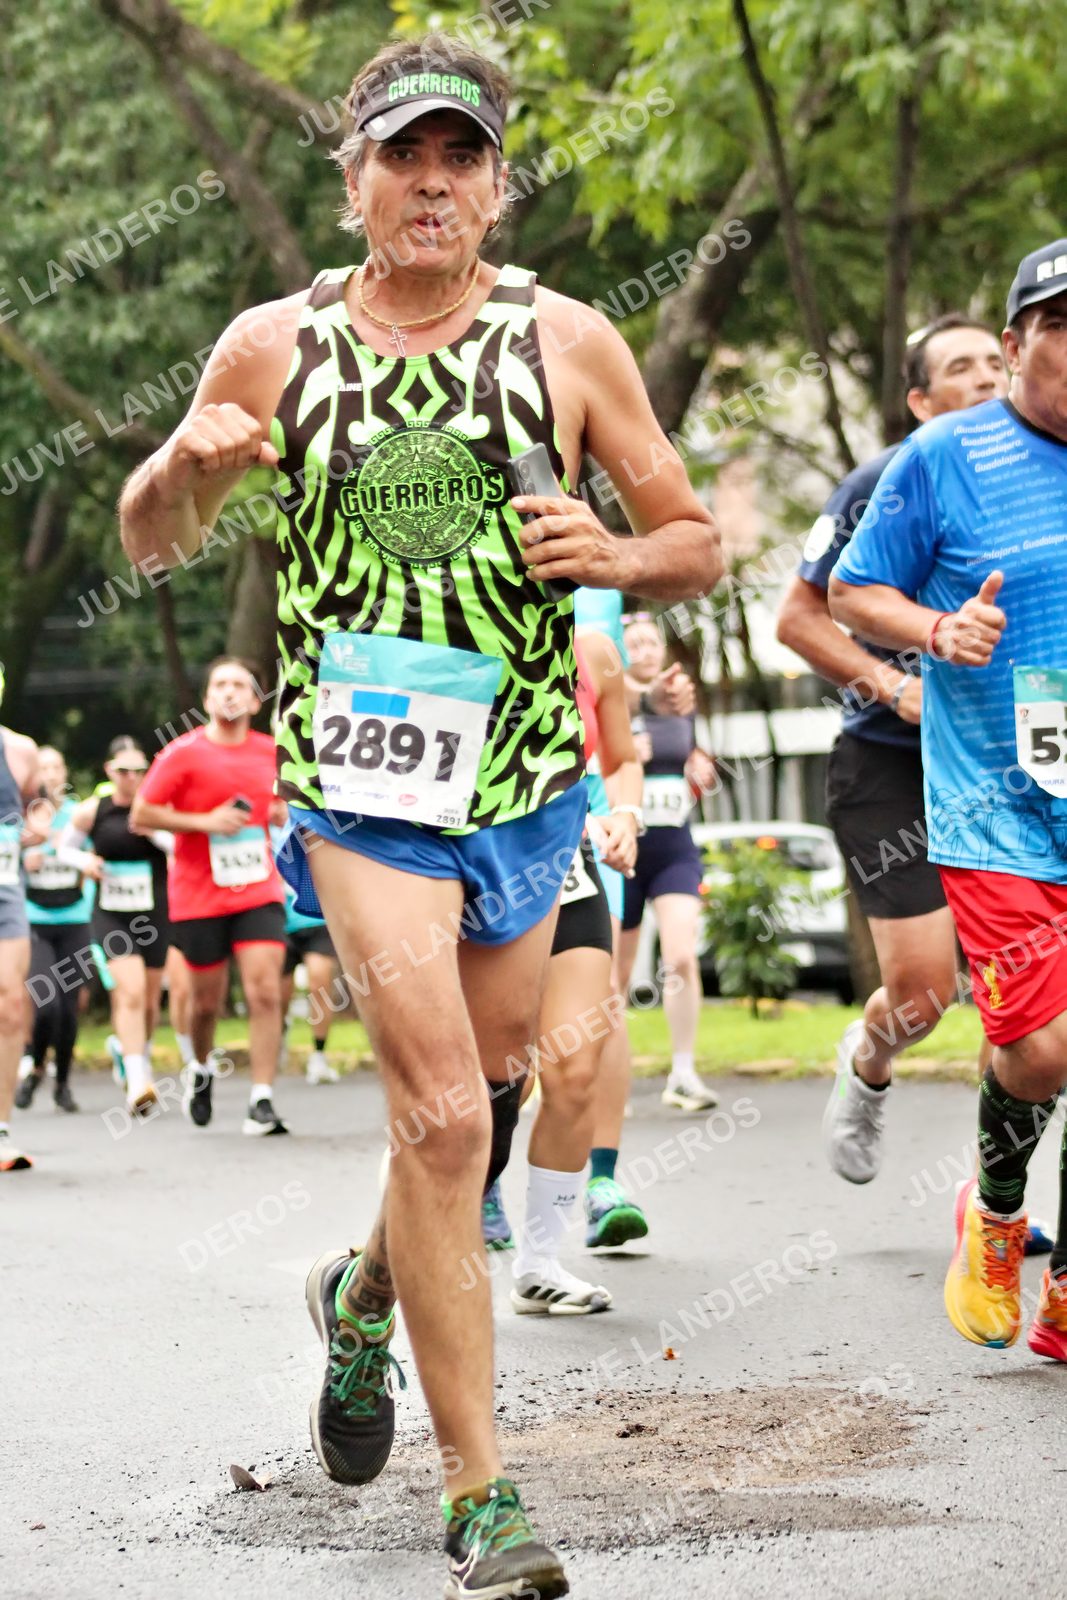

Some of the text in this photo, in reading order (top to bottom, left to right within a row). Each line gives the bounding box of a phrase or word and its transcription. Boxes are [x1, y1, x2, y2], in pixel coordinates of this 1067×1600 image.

[388, 72, 481, 108] GUERREROS
[340, 472, 505, 517] GUERREROS
[318, 714, 462, 782] 2891
[1030, 726, 1067, 766] 5
[436, 814, 461, 827] 2891
